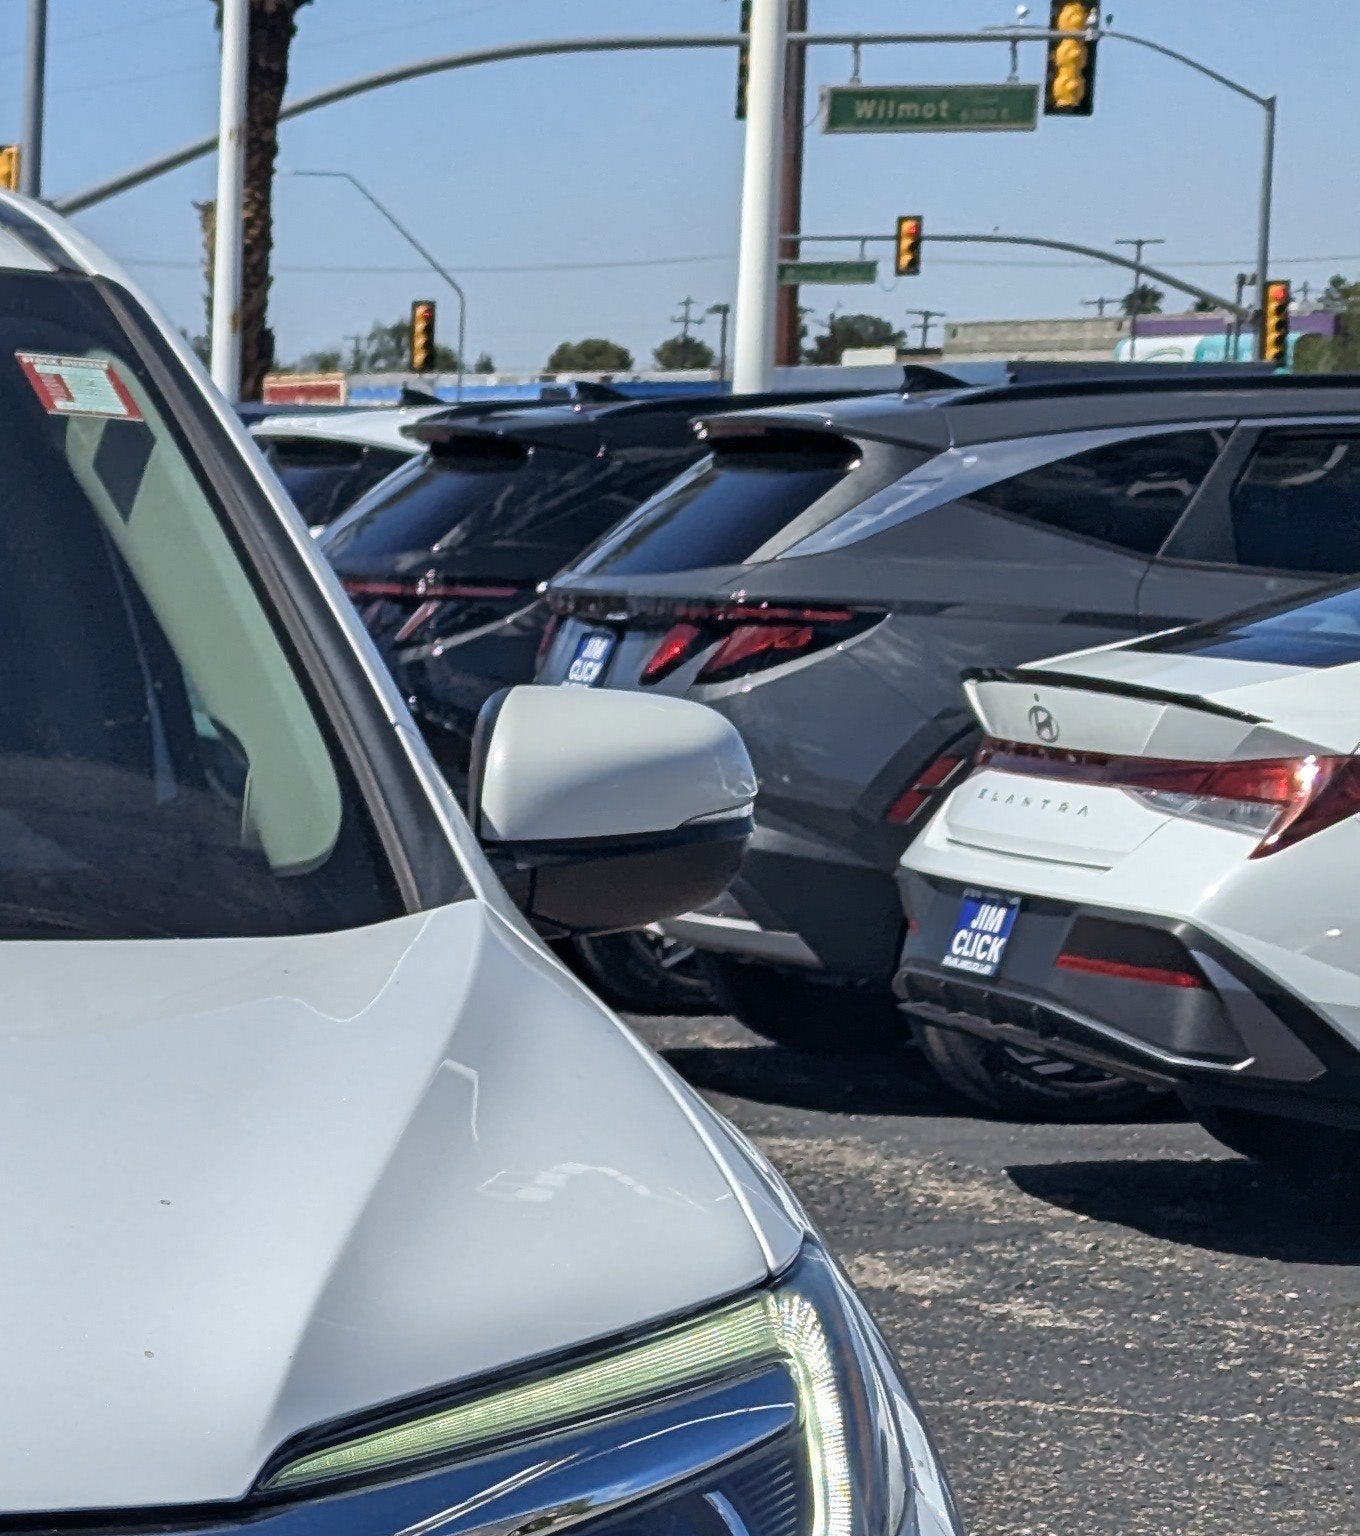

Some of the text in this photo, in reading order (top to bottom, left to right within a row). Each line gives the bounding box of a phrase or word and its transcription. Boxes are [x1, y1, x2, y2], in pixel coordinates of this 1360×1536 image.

[854, 99, 950, 119] Wilmot
[978, 788, 1089, 817] ELANTRA
[970, 904, 1007, 933] JIM
[952, 928, 1007, 963] CLICK
